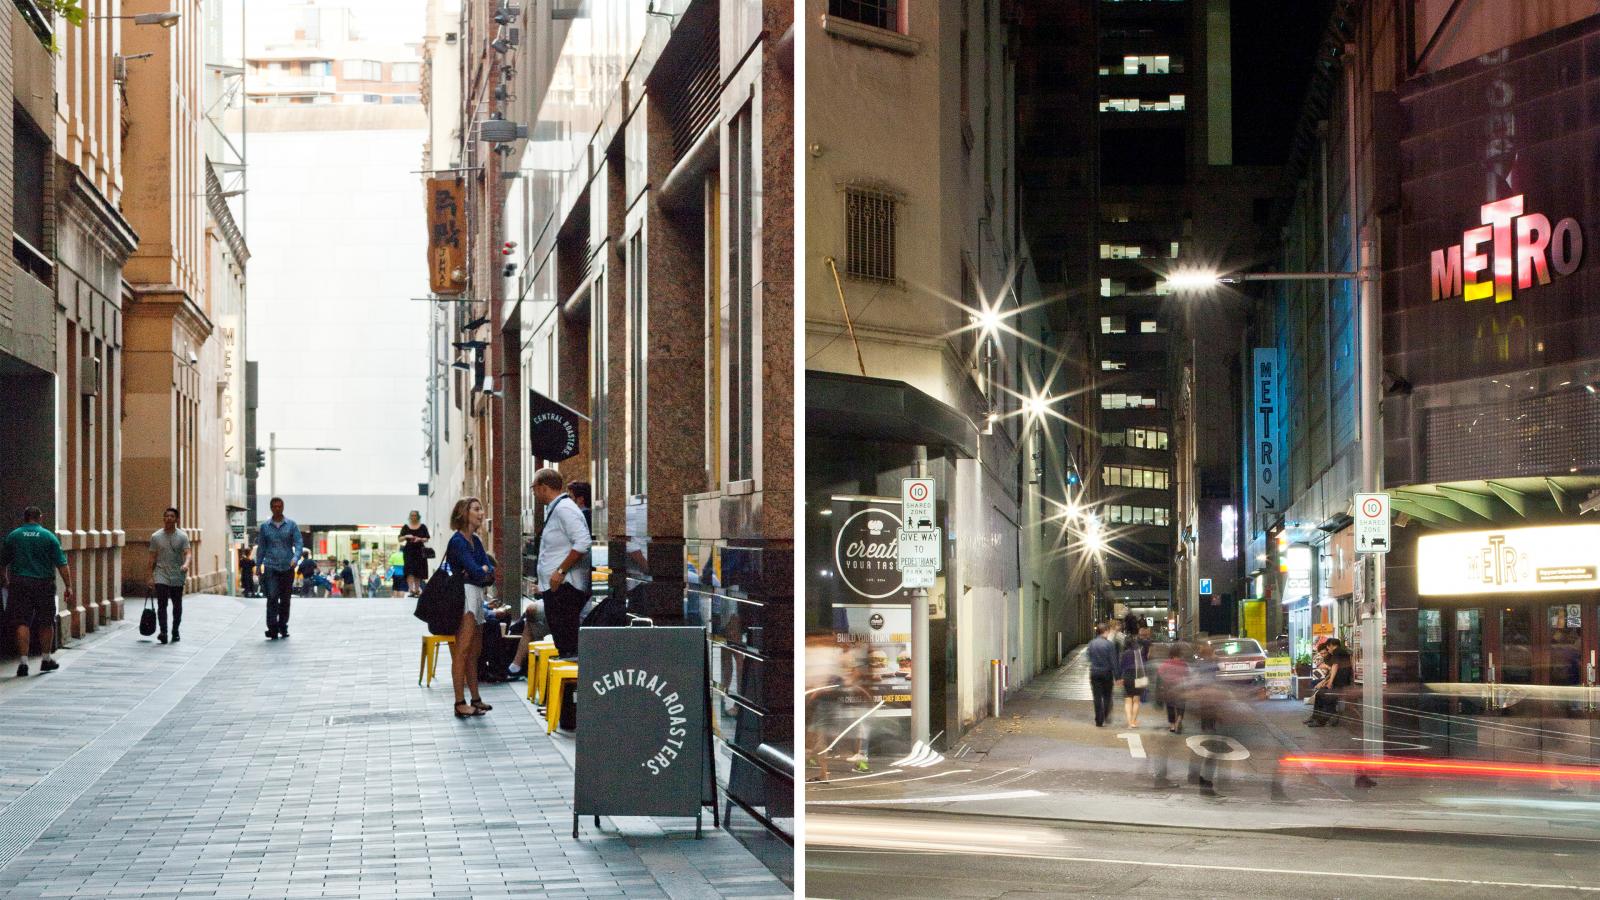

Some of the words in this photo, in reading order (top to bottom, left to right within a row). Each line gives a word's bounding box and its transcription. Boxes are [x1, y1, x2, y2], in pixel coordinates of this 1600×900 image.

[1431, 194, 1583, 304] METRO
[533, 412, 563, 424] CENTRAL
[1259, 362, 1274, 485] METRO
[914, 488, 923, 496] 10
[1367, 503, 1377, 513] 10
[900, 533, 918, 542] GIVE
[921, 533, 938, 541] WAY
[915, 545, 924, 553] TO
[846, 560, 872, 569] YOUR
[877, 561, 898, 570] TAS
[1466, 534, 1531, 586] METRO
[837, 633, 856, 642] BUILD
[857, 633, 873, 642] YOUR
[875, 633, 890, 642] OWN
[592, 669, 668, 696] CENTRAL
[641, 691, 687, 776] ROASTERS.
